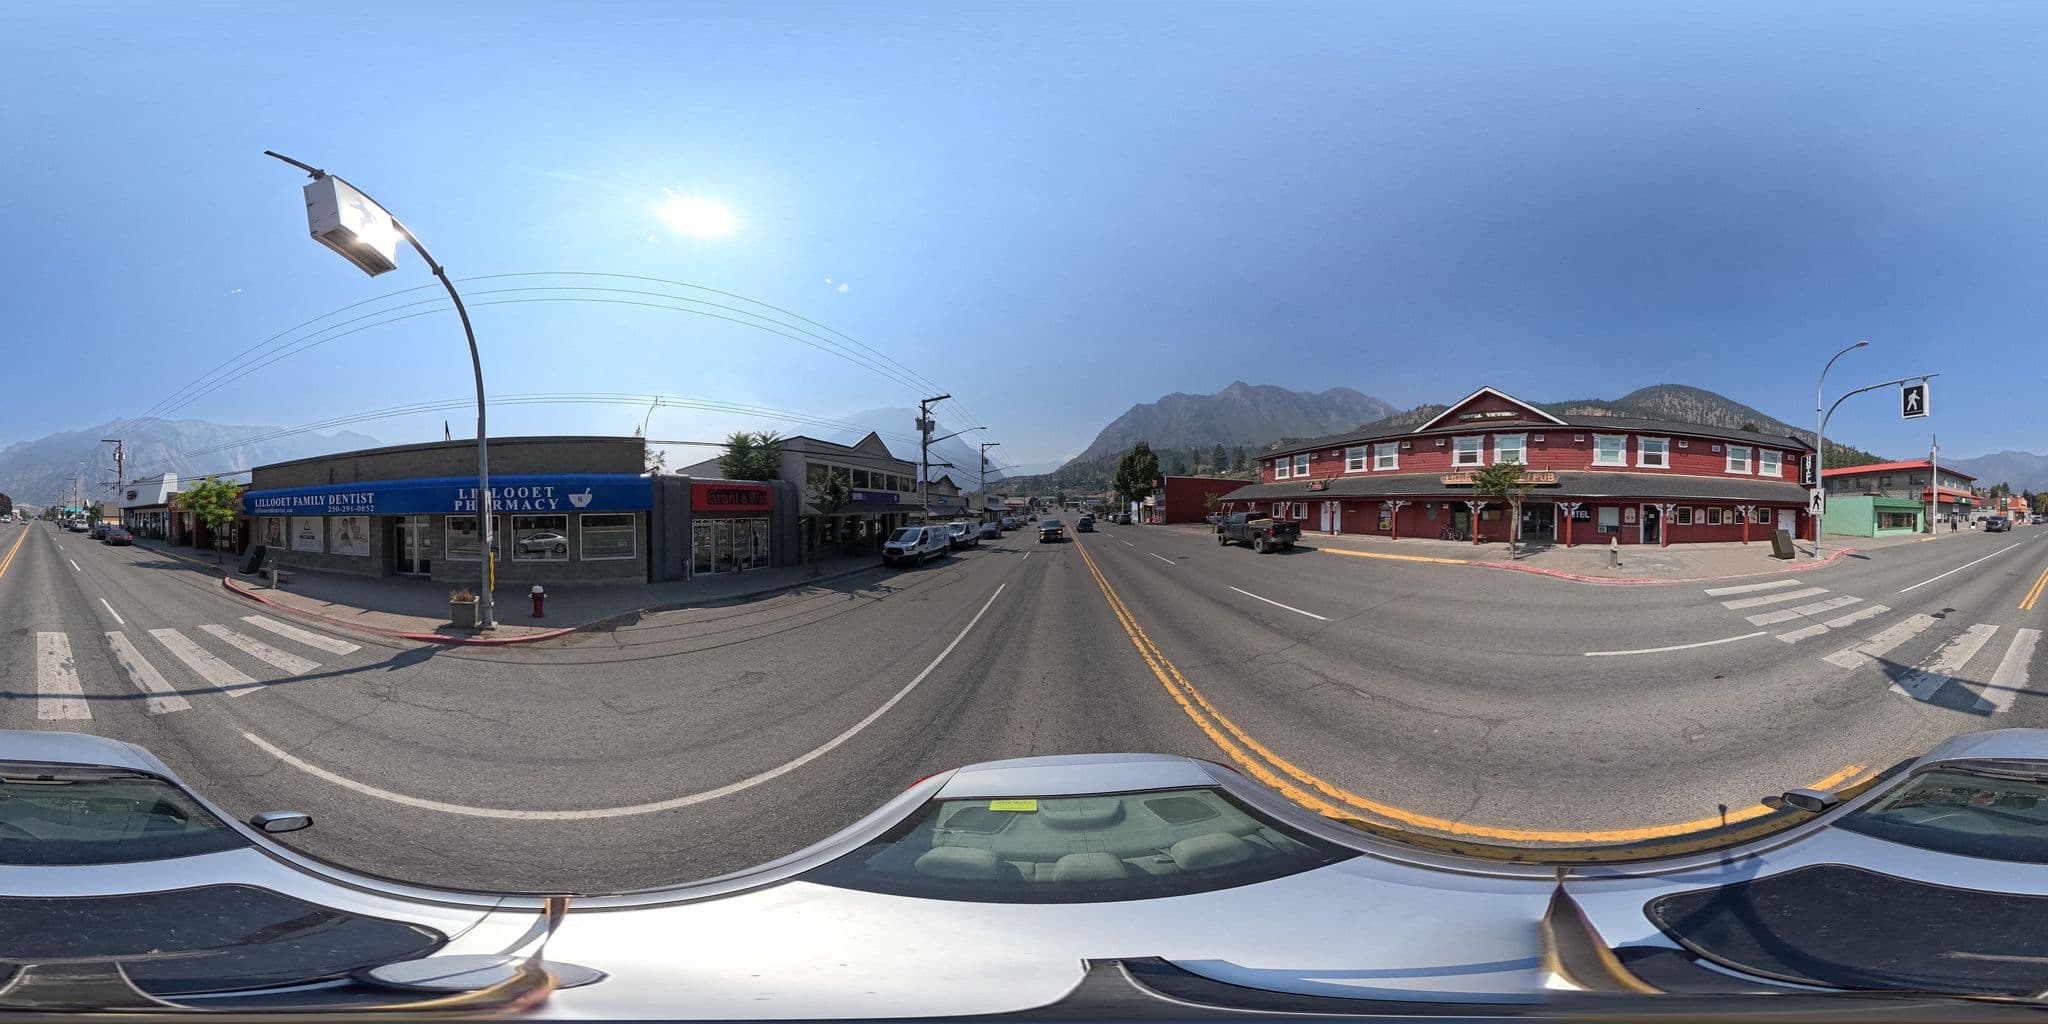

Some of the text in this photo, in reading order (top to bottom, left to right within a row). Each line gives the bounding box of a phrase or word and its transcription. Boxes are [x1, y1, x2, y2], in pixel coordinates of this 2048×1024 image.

[1532, 472, 1555, 482] PUB
[459, 486, 555, 499] LILOOET
[255, 492, 375, 508] LILLOOET FAMILY DENTIST
[454, 498, 559, 511] PHRMACY
